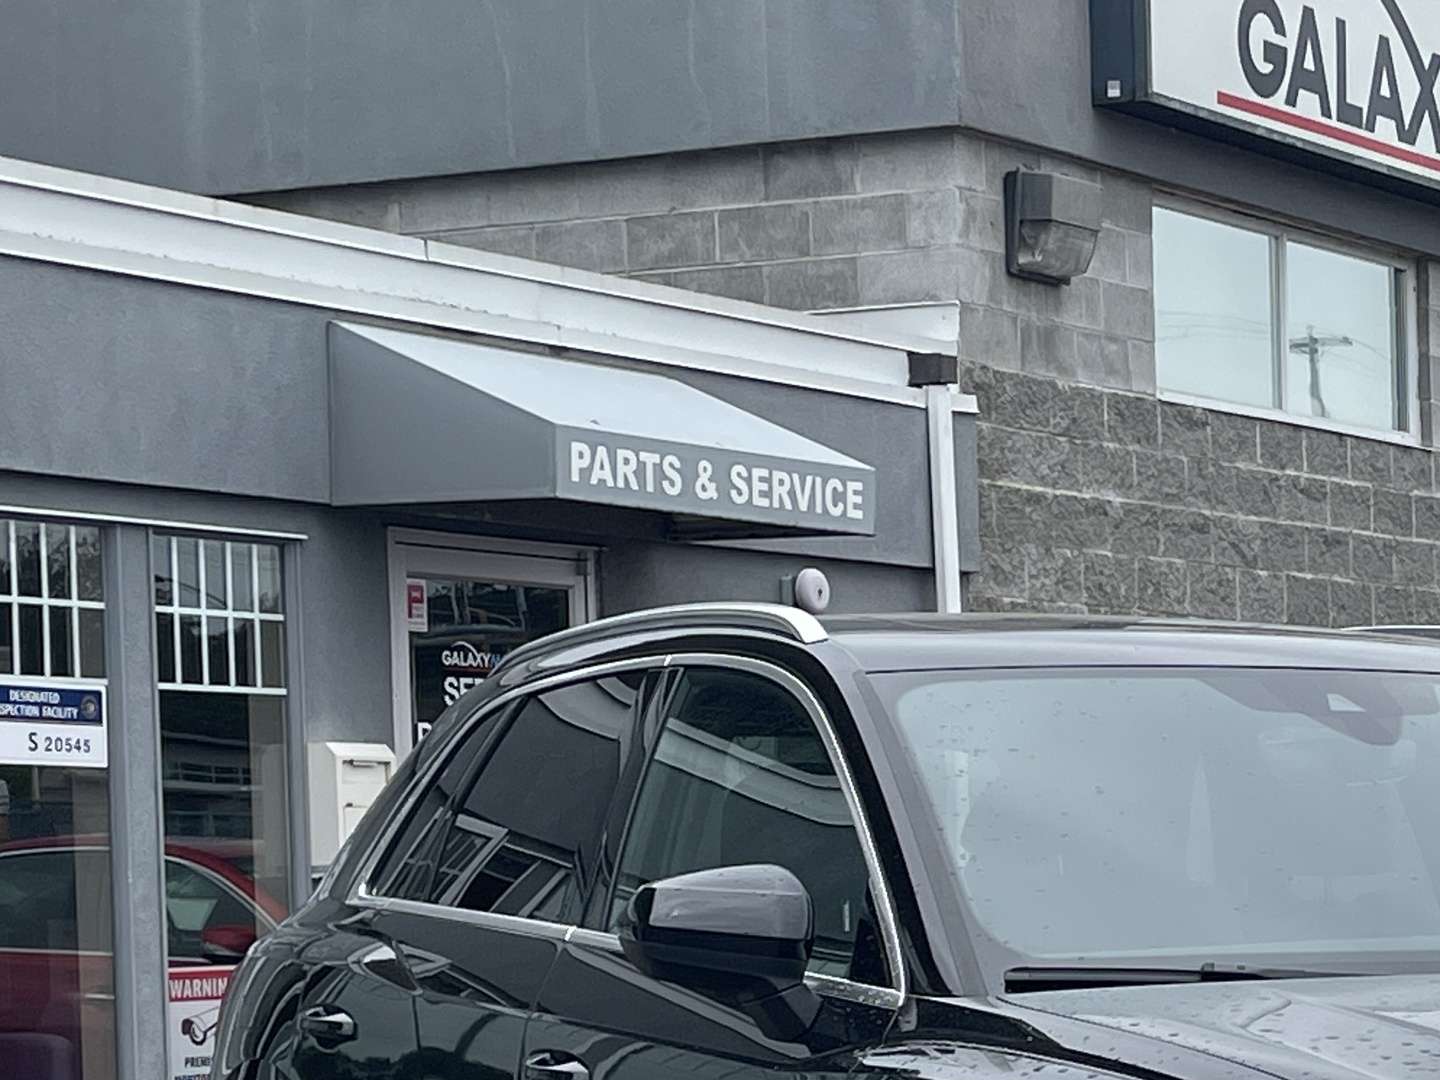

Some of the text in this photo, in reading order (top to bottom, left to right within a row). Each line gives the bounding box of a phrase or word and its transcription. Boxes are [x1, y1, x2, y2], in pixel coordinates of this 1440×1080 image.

[570, 441, 864, 520] PARTS & SERVICE
[41, 705, 79, 719] FACILITY
[28, 731, 91, 753] S 20545
[169, 977, 228, 998] WARNIN
